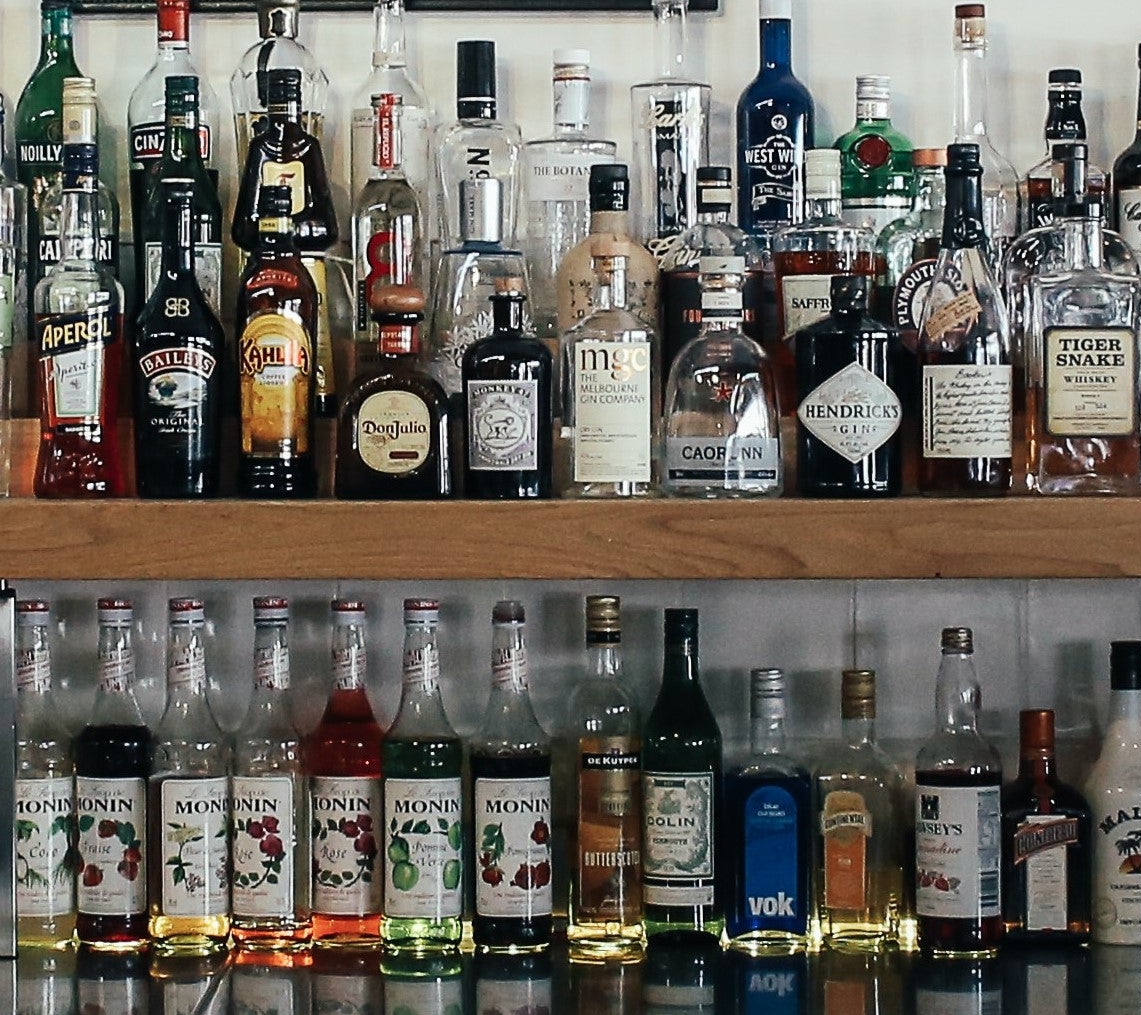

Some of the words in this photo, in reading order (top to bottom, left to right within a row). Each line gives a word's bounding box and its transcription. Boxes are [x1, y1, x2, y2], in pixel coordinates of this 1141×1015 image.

[20, 144, 62, 162] NOILLY
[744, 148, 775, 164] WEST
[534, 166, 551, 176] THE
[553, 166, 591, 176] BOTAN
[42, 316, 112, 351] APEROL
[1058, 338, 1122, 352] TIGER
[580, 348, 648, 382] mgc
[1056, 353, 1125, 367] SNAKE
[580, 373, 598, 383] THE
[1063, 375, 1118, 384] WHISKEY
[806, 403, 898, 419] HENDRICK'S
[647, 816, 695, 827] DOLIN
[748, 891, 795, 917] vok
